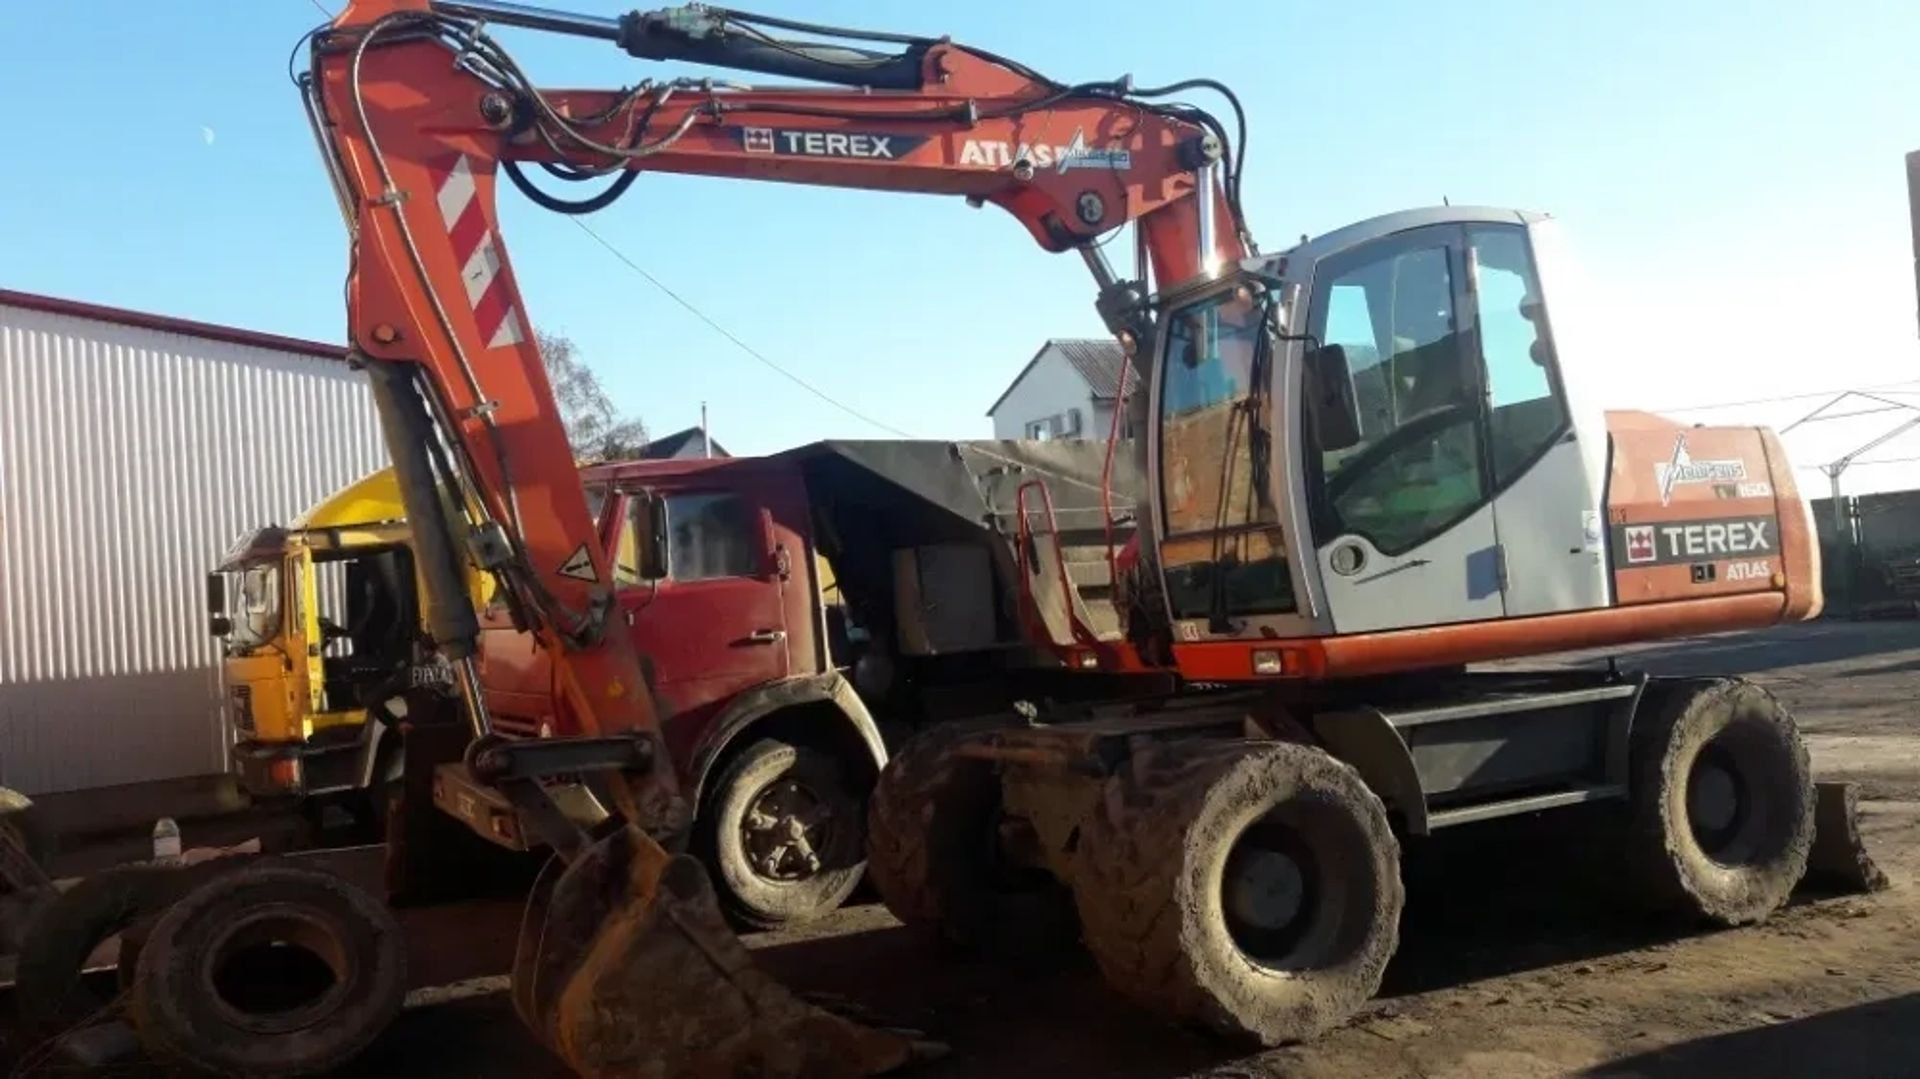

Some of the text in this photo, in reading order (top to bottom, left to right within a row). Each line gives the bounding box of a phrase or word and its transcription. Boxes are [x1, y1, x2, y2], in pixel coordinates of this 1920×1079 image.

[782, 131, 893, 158] TEREX
[959, 139, 1052, 168] ATLAS
[1662, 521, 1770, 556] TEREX
[1726, 560, 1770, 581] ATLAS
